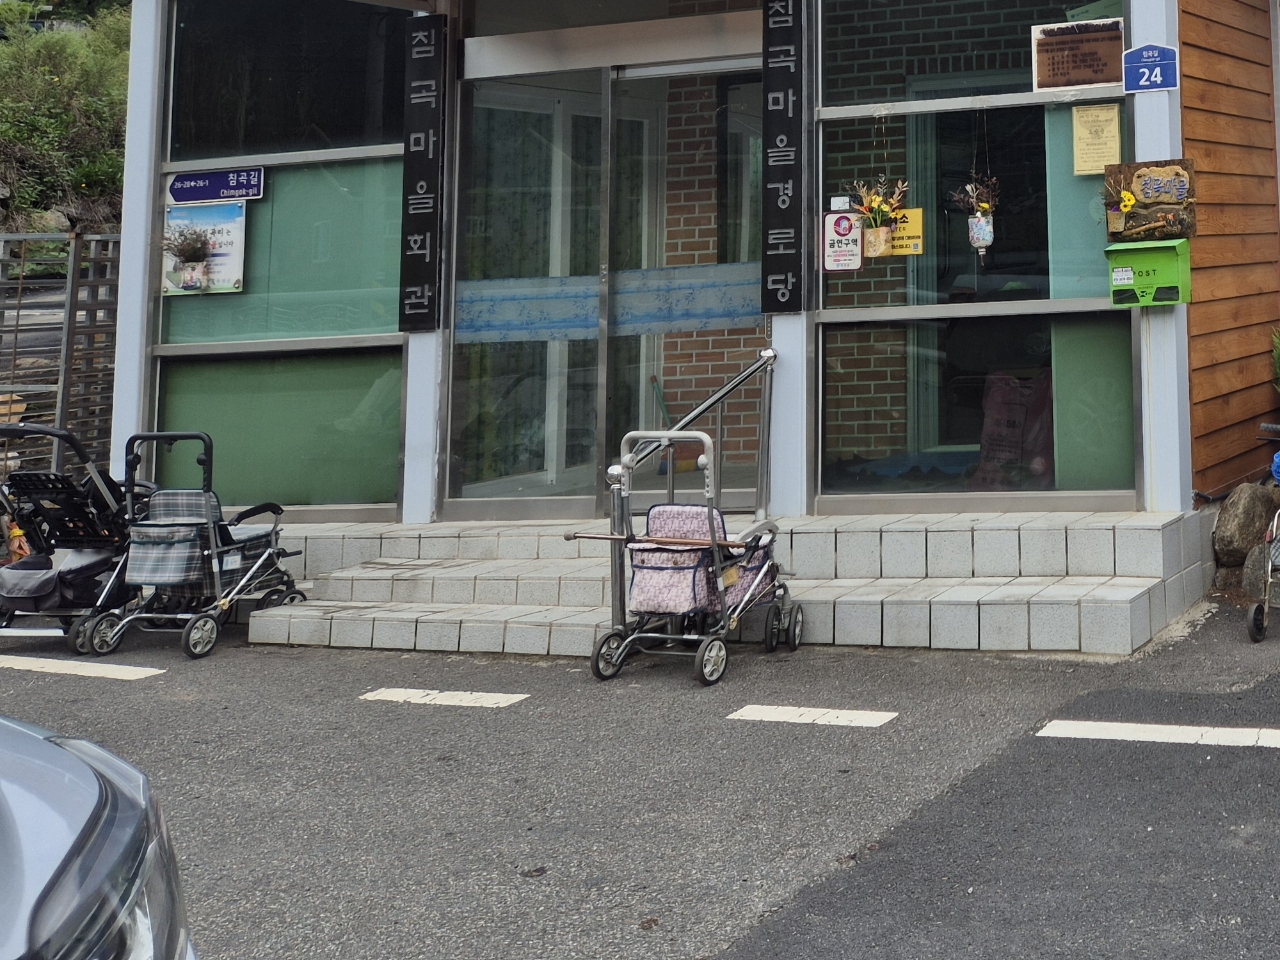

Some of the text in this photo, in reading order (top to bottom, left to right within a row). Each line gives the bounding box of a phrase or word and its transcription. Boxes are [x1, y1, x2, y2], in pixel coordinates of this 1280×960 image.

[1138, 66, 1163, 86] 24
[228, 171, 258, 186] 침곡길
[220, 187, 258, 197] Chimgok-gil
[1141, 176, 1189, 200] 침곡마을
[828, 238, 858, 249] 금연구역
